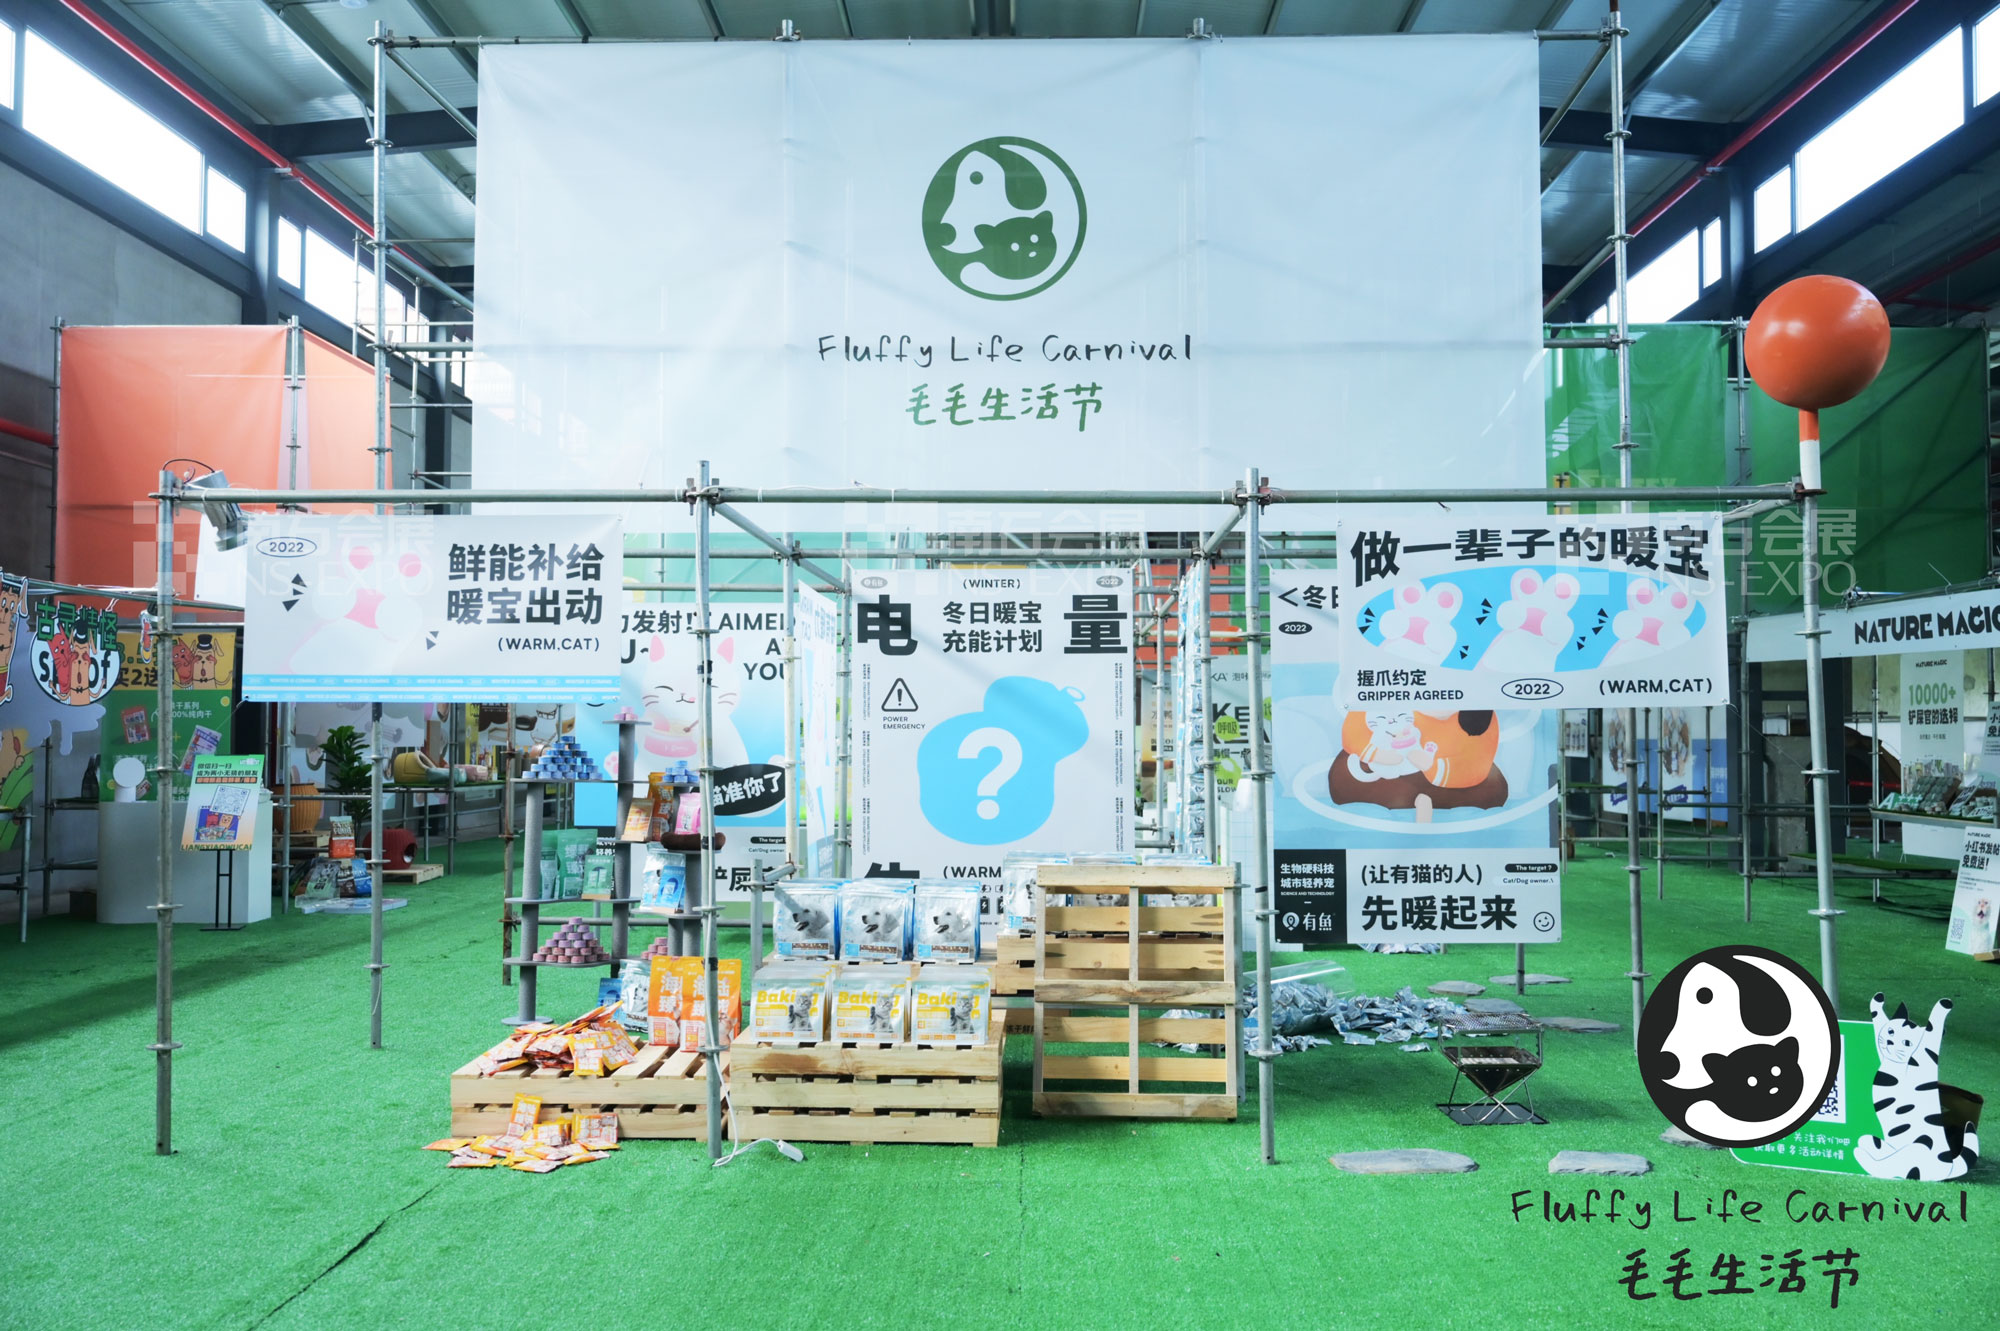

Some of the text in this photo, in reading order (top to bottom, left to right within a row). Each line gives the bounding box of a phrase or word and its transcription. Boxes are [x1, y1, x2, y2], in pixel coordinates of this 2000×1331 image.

[817, 333, 1192, 368] Fluffy Life Carnival
[905, 381, 1103, 432] 毛毛生活节
[269, 542, 304, 553] 2022
[1350, 524, 1710, 588] 做一辈子的暖宝
[448, 542, 605, 582] 鲜能补给
[963, 578, 1021, 589] (WINTER)
[1100, 578, 1119, 586] 2022
[447, 586, 603, 625] 暖宝出动
[942, 600, 1042, 625] 冬日暖宝
[857, 594, 918, 656] 电
[1063, 594, 1128, 654] 量
[1284, 624, 1307, 632] 2022
[1854, 612, 1933, 645] NATURE
[942, 629, 1043, 653] 充能计划
[1357, 669, 1427, 687] 握爪约定
[1514, 683, 1551, 696] 2022
[1357, 689, 1464, 702] GRIPPER AGREED
[1908, 682, 1957, 706] 10000+
[1217, 721, 1238, 735] 呼吸
[1280, 863, 1335, 875] 生物硬科技
[1361, 863, 1483, 887] (让有猫的人)
[1529, 864, 1546, 872] target
[1280, 878, 1335, 889] 城市轻养宠
[1361, 894, 1518, 931] 先暖起来
